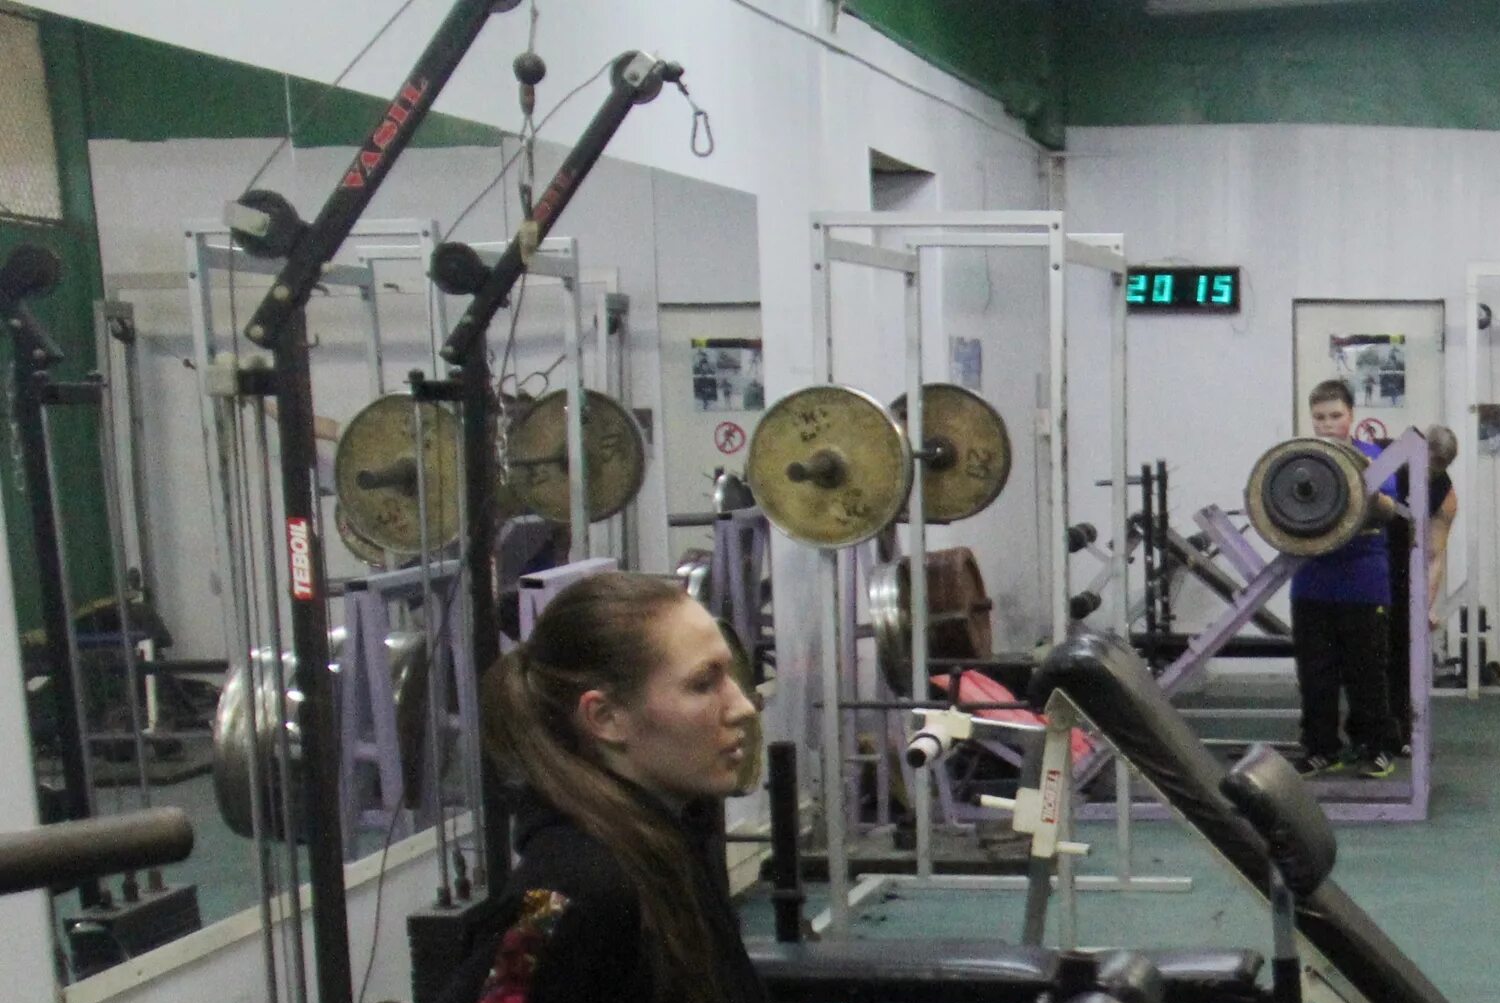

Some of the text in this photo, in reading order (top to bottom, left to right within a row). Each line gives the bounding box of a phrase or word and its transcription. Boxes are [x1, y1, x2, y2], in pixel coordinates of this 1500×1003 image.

[342, 78, 429, 187] VASIL
[1126, 274, 1233, 304] 20 15
[289, 520, 312, 594] TEBOIL
